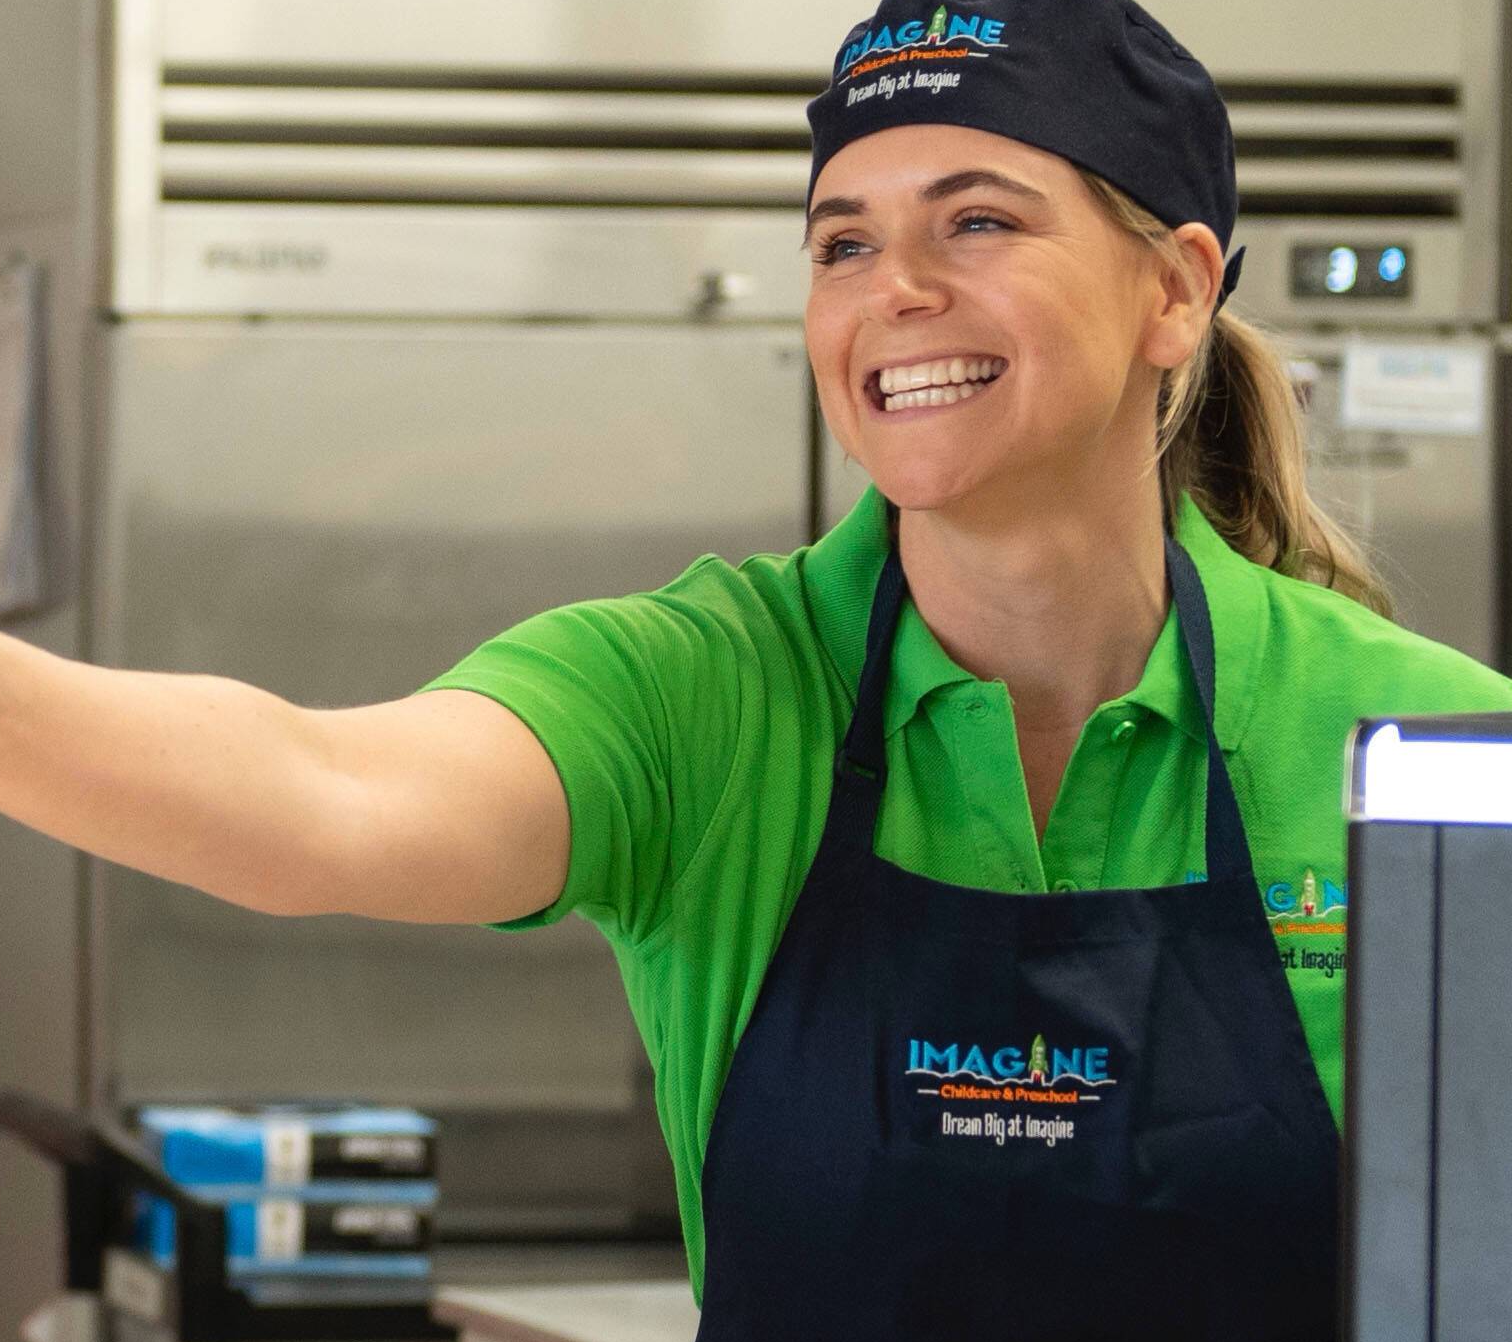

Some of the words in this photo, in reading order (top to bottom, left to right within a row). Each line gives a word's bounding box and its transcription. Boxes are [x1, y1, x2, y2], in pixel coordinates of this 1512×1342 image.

[851, 55, 896, 78] Childcare
[899, 50, 908, 62] &
[909, 48, 969, 61] Preschool
[846, 82, 877, 107] Dream
[877, 70, 897, 99] Big
[897, 71, 911, 91] at
[913, 69, 961, 94] Imagine
[940, 1084, 1001, 1100] Childcare
[1003, 1087, 1014, 1100] &
[1015, 1088, 1078, 1103] Preschool
[942, 1112, 982, 1137] Dream
[984, 1113, 1005, 1145] Big
[1007, 1114, 1023, 1138] at
[1026, 1114, 1074, 1147] Imagine
